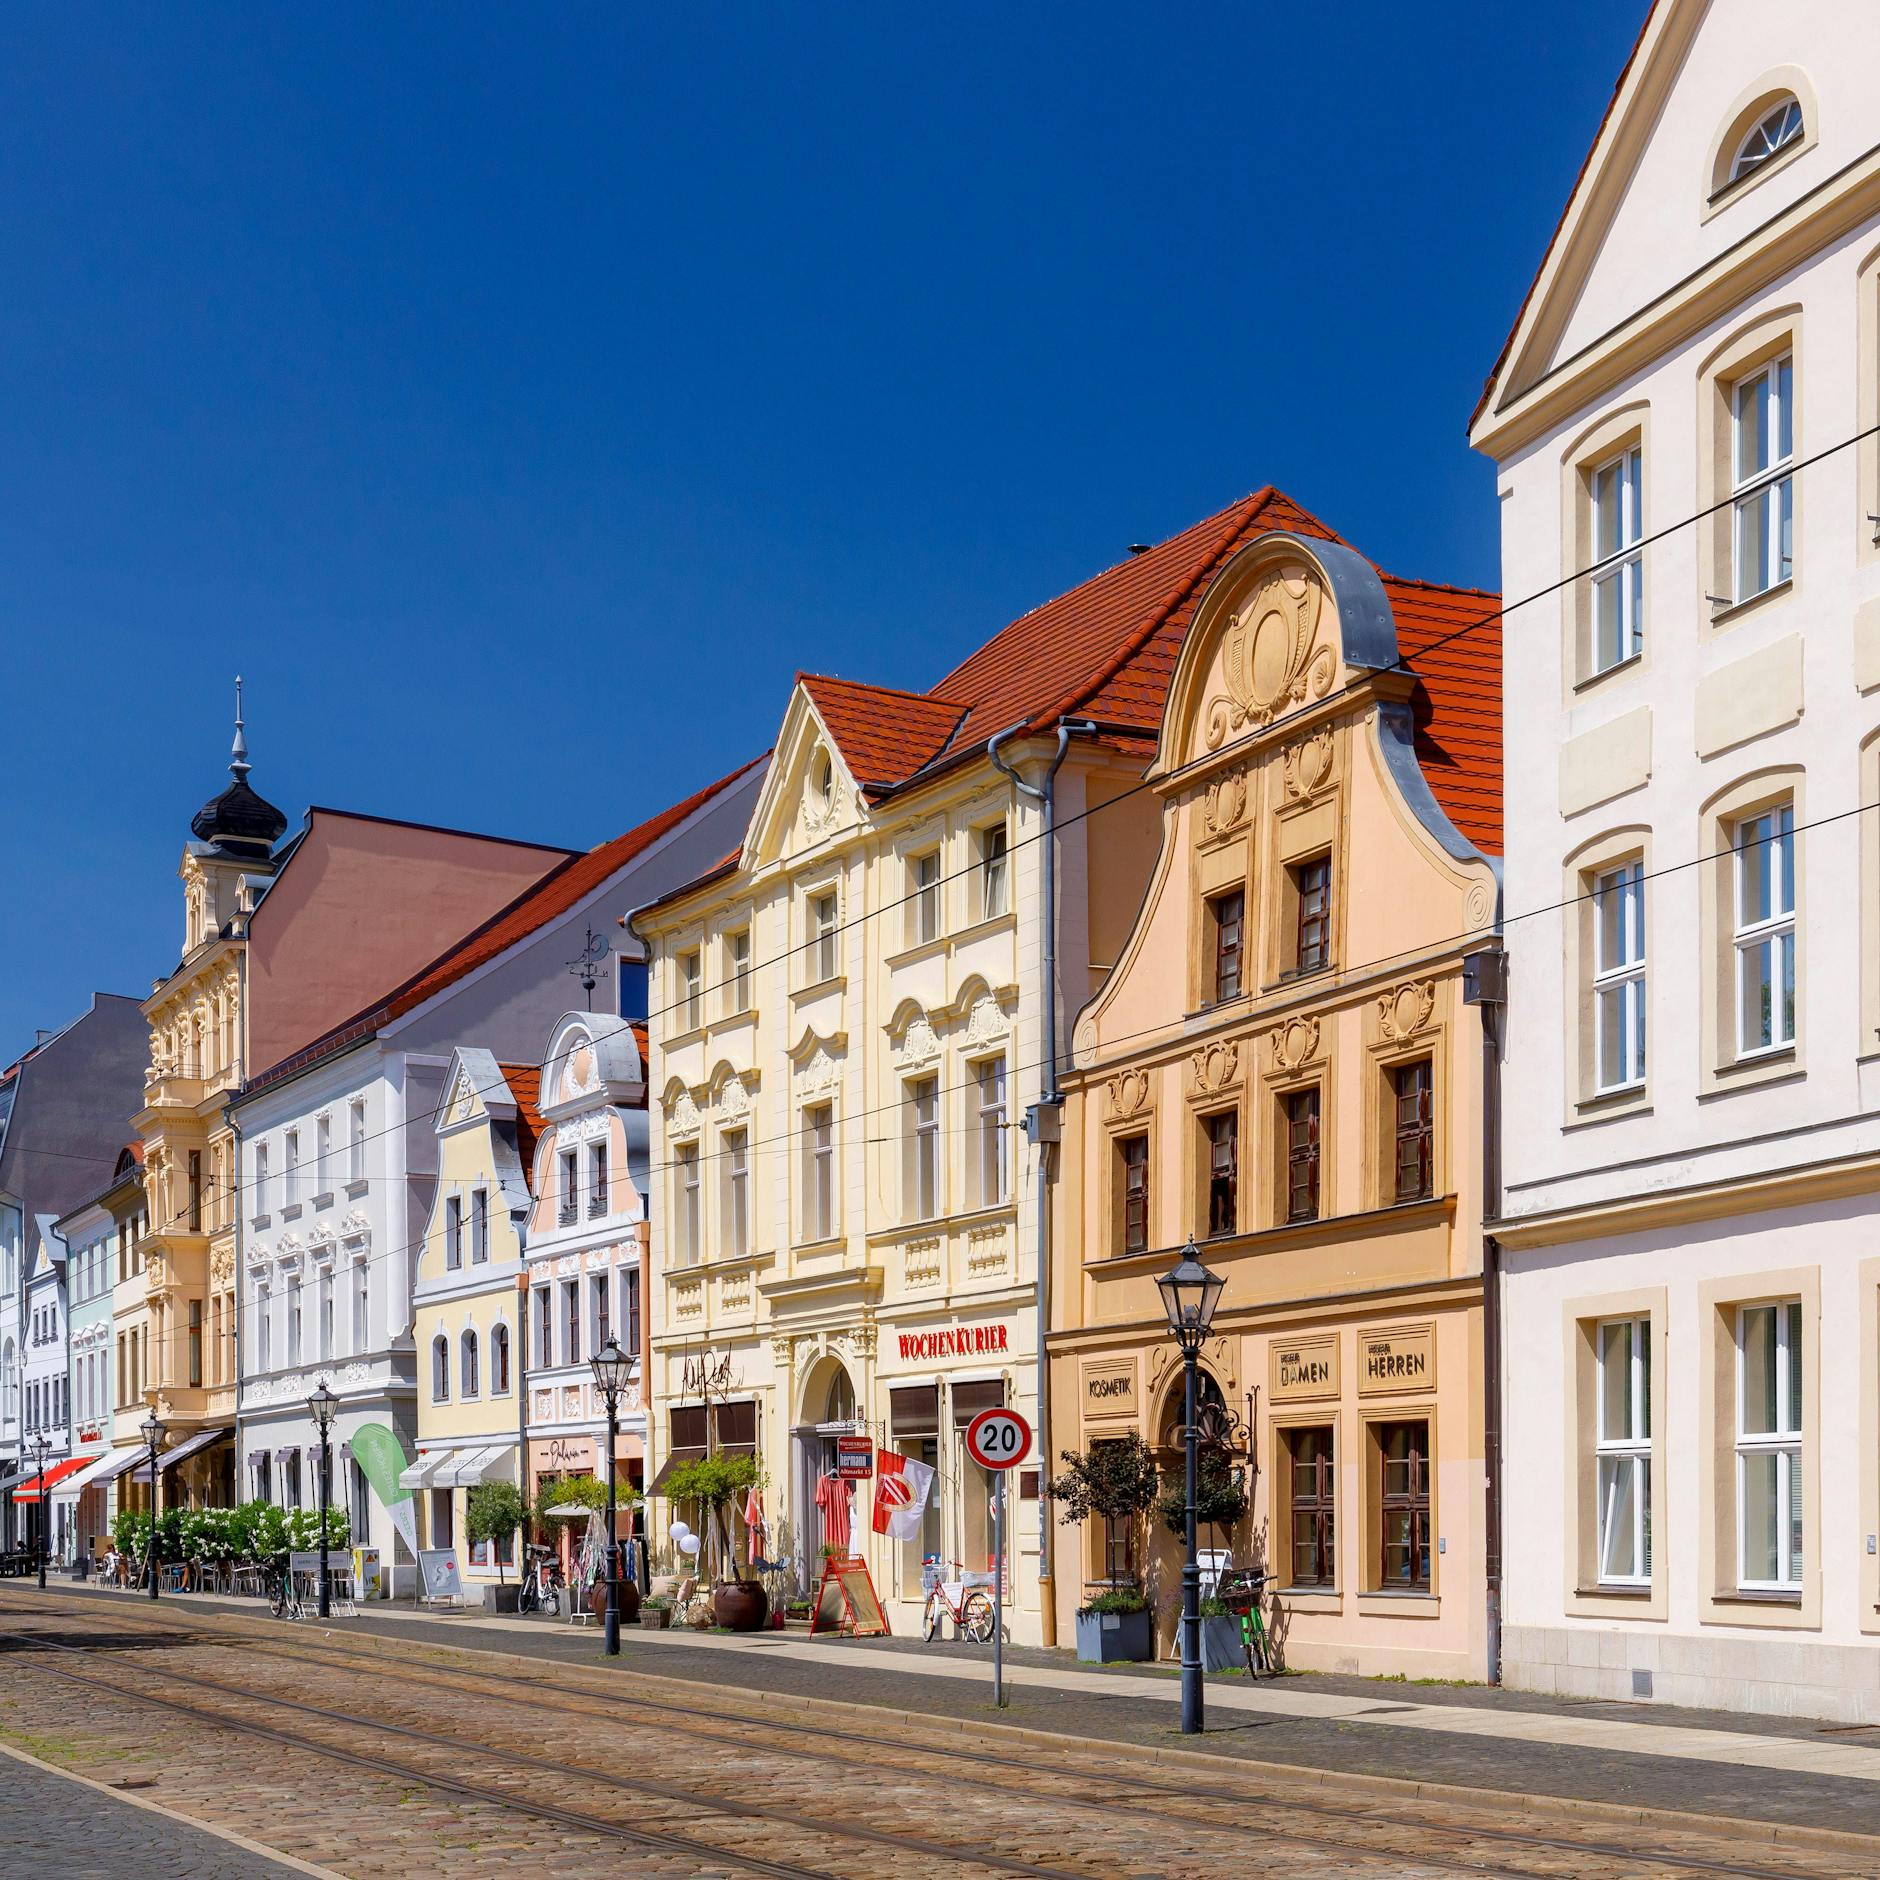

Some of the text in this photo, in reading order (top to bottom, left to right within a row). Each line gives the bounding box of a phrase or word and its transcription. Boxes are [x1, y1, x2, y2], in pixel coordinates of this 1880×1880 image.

[898, 1325, 1008, 1360] WOCHENKURIER
[1281, 1362, 1328, 1386] DAMEN
[1368, 1353, 1424, 1377] HERREN
[1089, 1377, 1132, 1398] KOSMETIK
[983, 1424, 1016, 1452] 20
[840, 1453, 866, 1466] hermann
